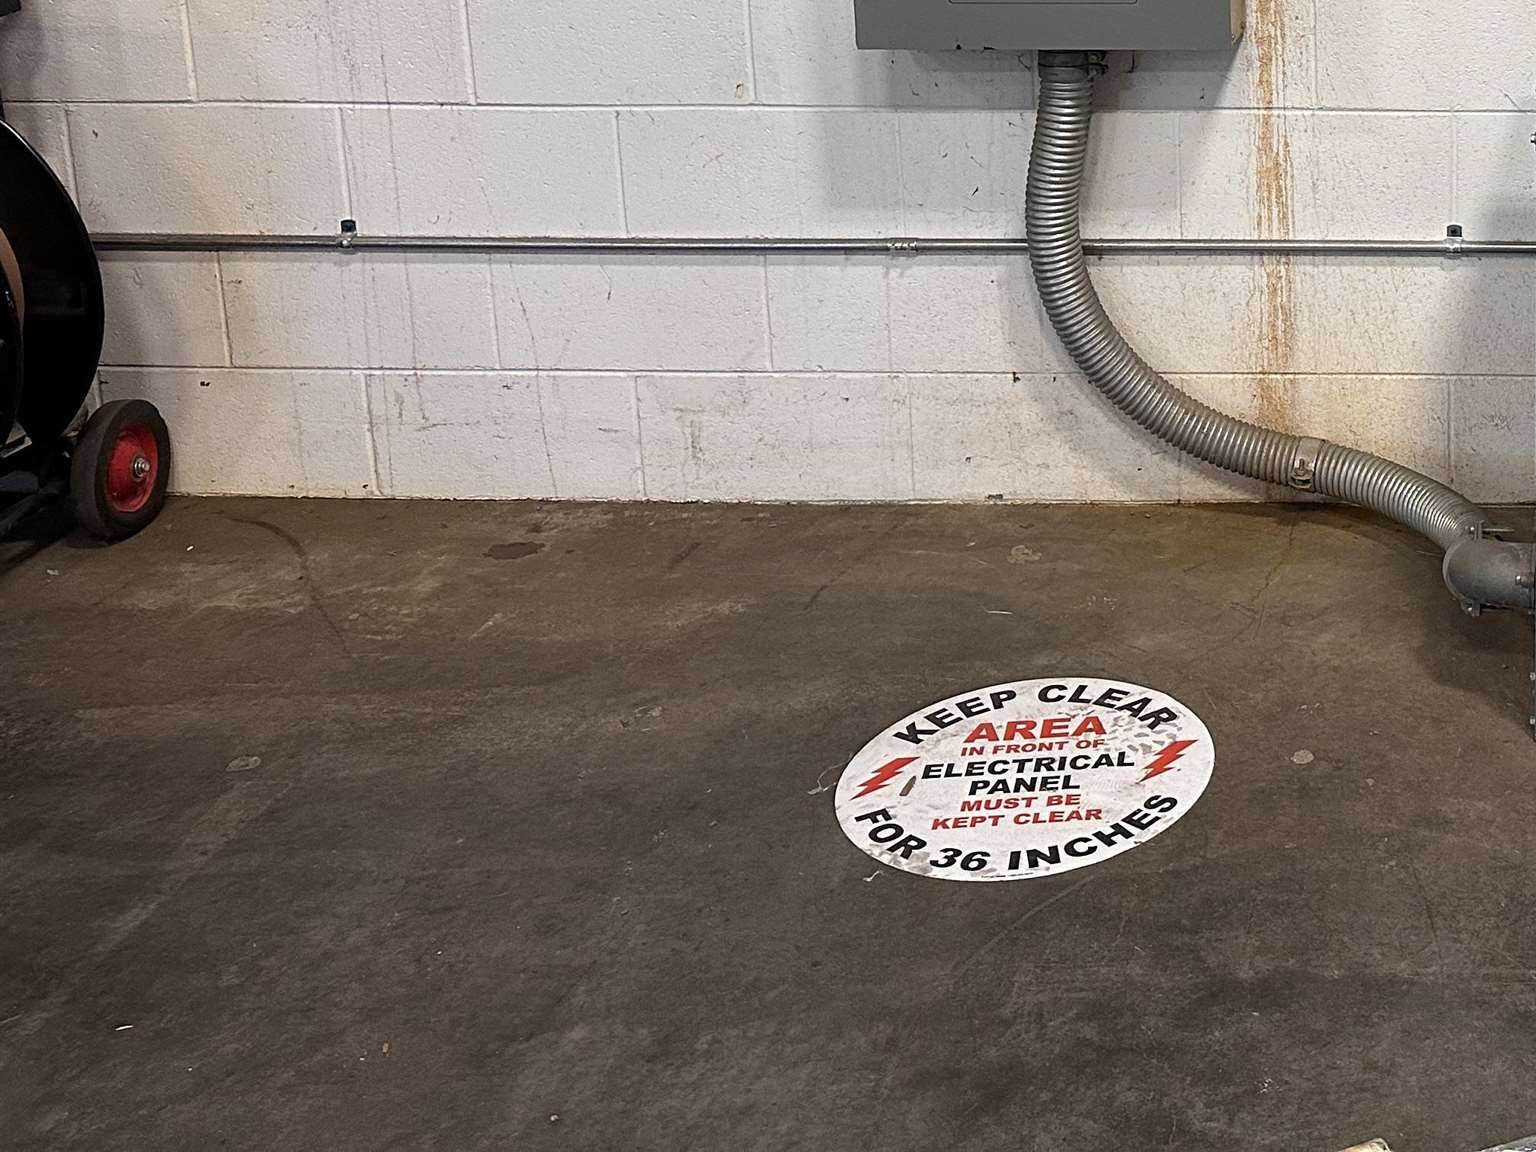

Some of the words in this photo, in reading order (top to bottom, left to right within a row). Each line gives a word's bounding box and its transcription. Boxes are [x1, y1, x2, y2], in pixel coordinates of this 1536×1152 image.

[893, 689, 1018, 746] KEEP
[1038, 684, 1178, 731] CLEAR
[963, 715, 1108, 744] AREA
[960, 744, 987, 757] IN
[992, 740, 1069, 756] FRONT
[1076, 738, 1106, 750] OF
[921, 751, 1135, 780] ELECTRICAL
[968, 775, 1081, 796] PANEL
[960, 796, 1043, 812] MUST
[1046, 794, 1082, 807] BE
[931, 815, 1005, 831] KEPT
[1013, 808, 1103, 826] CLEAR
[855, 807, 928, 860] FOR
[929, 847, 990, 872] 36
[1007, 794, 1179, 870] INCHES
